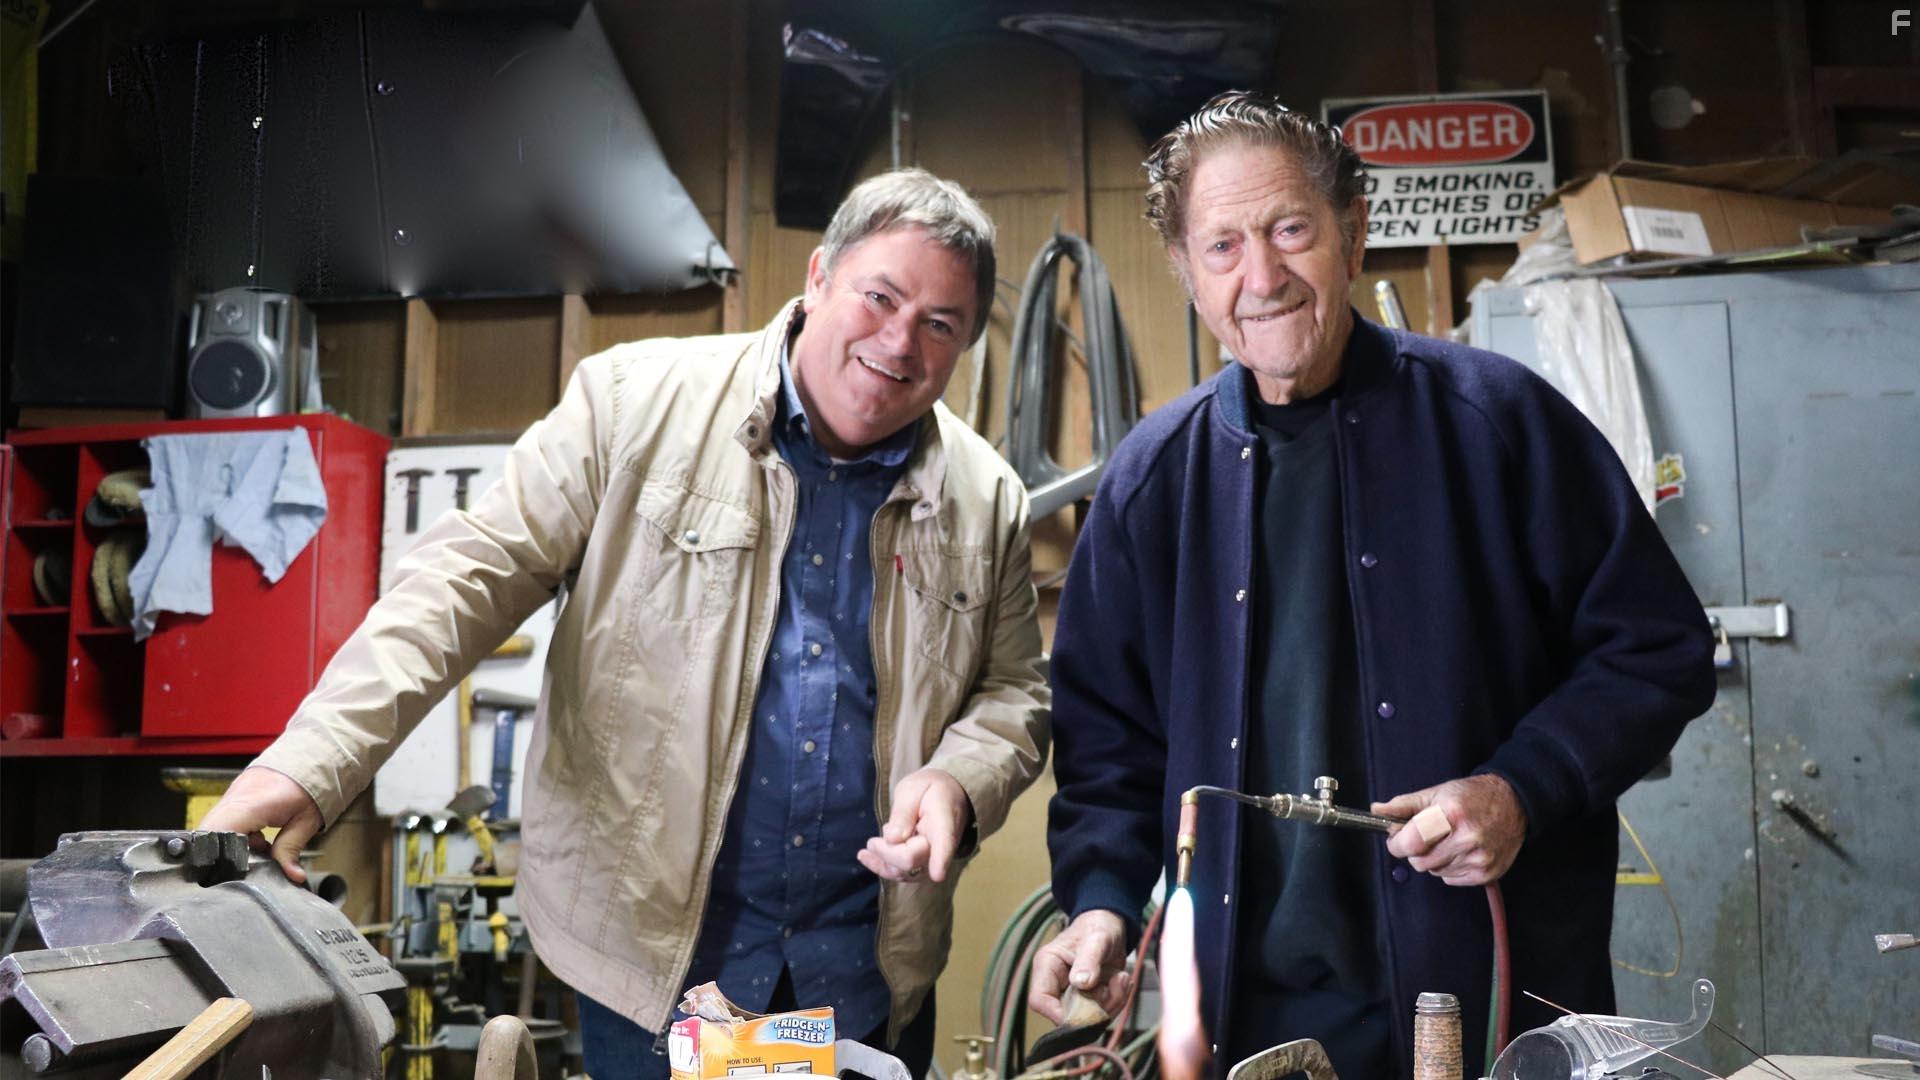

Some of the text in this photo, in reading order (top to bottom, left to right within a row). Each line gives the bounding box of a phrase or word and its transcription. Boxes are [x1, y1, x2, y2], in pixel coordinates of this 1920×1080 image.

[1353, 113, 1520, 152] DANGER
[1367, 215, 1541, 239] PEN LIGHTS
[774, 1018, 830, 1032] FRIDGE-N-
[777, 1029, 825, 1043] FREEZER
